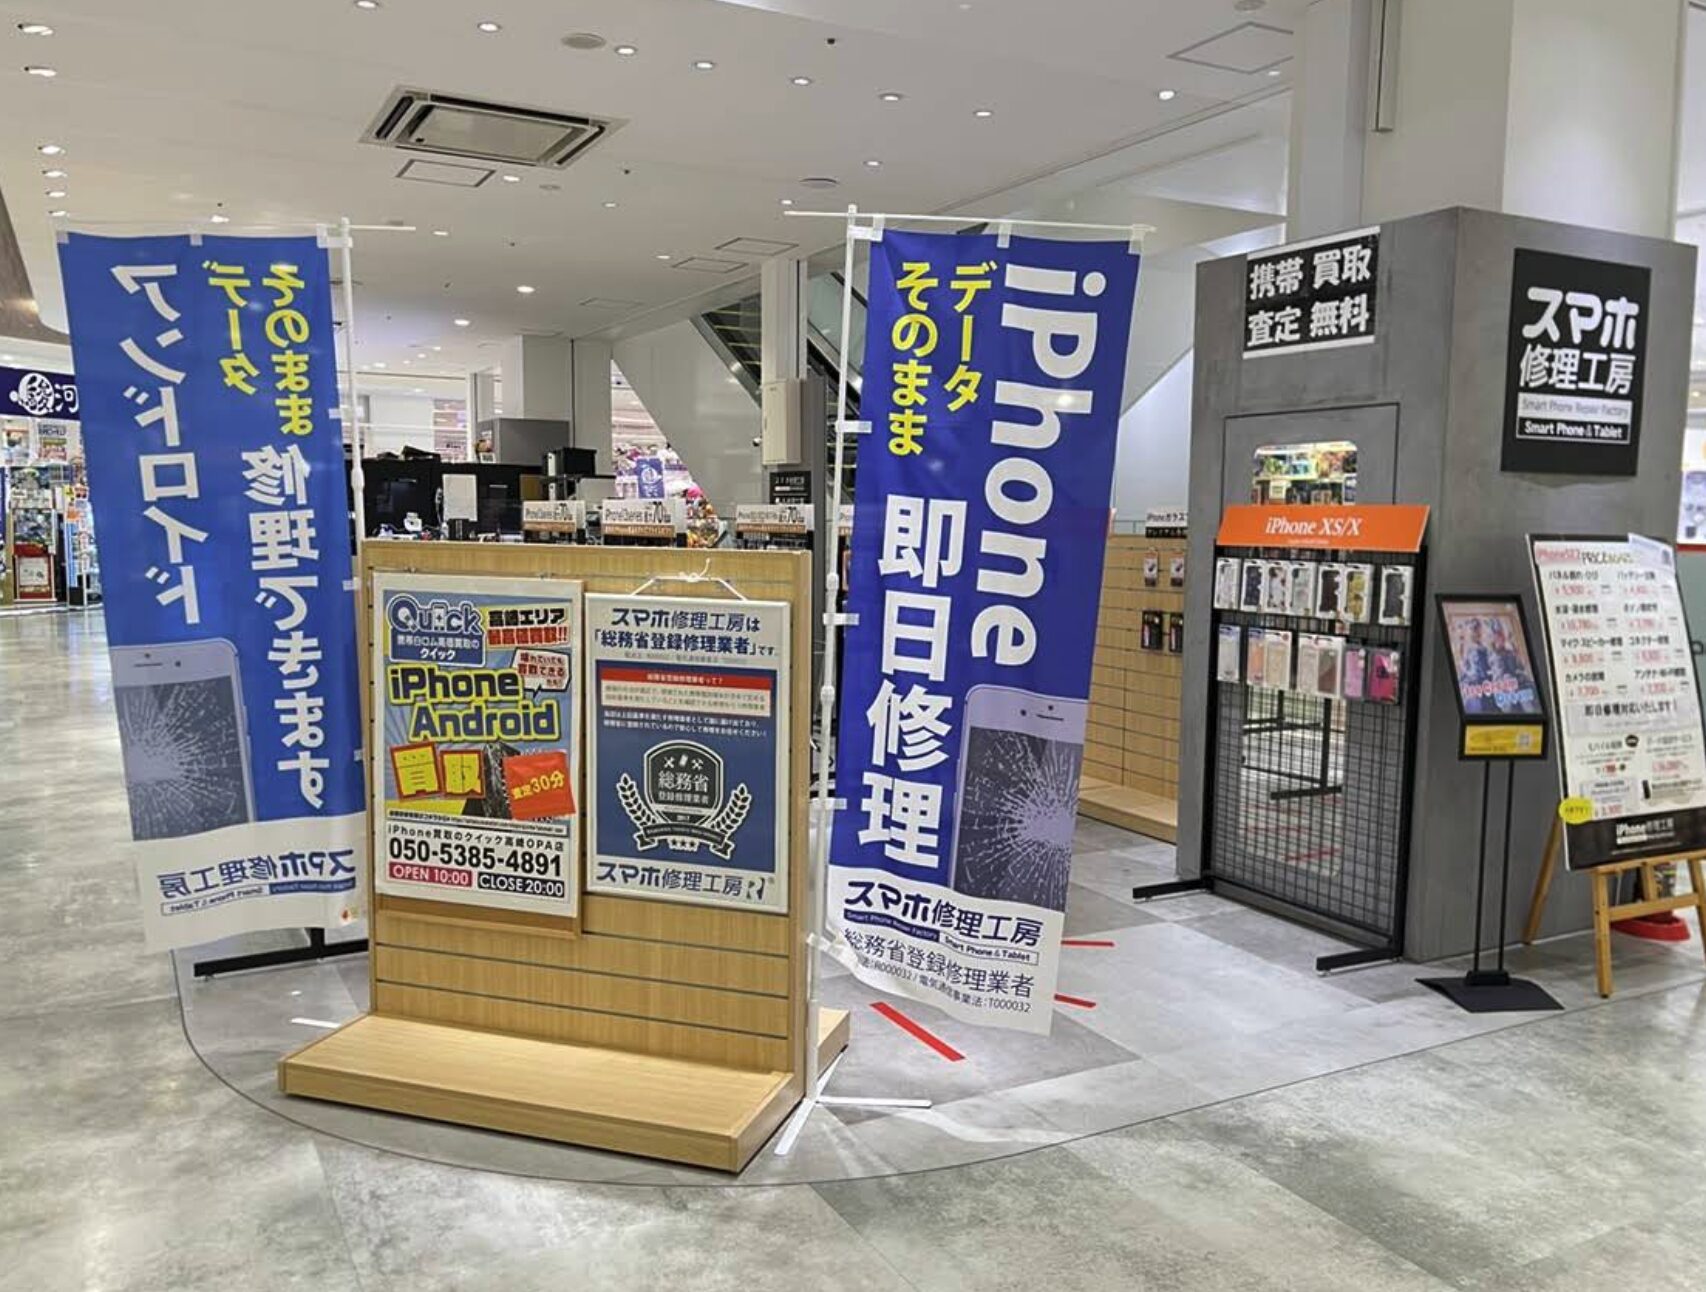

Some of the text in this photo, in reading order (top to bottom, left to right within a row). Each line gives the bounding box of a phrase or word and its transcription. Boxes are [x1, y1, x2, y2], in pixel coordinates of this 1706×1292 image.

[1250, 244, 1372, 300] 携帯 買取
[944, 260, 998, 412] データ
[1247, 294, 1369, 346] 査定 無料
[1522, 286, 1639, 350] スマホ
[1520, 343, 1636, 394] 修理工房
[1524, 420, 1555, 435] Smart
[1556, 422, 1585, 437] Phone
[1594, 425, 1623, 439] Tablet
[971, 263, 1107, 665] iPhone
[1265, 516, 1363, 536] iPhone XS/X
[858, 262, 968, 869] そのまま 即日修理
[611, 607, 761, 632] スマホ修理工房は
[420, 648, 457, 660] クイック
[390, 667, 519, 700] iPhone
[412, 703, 556, 738] Android
[658, 771, 710, 793] 総務省
[389, 837, 561, 877] 050-5385-4891
[393, 864, 469, 886] OPEN 10:00
[479, 874, 564, 897] CLOSE 20:00
[596, 861, 743, 897] スマホ修理工房
[844, 881, 1044, 947] スマホ修理工房
[844, 926, 1035, 998] 総務省登録修理業者
[965, 944, 993, 957] Phone
[1002, 948, 1031, 962] Tablet
